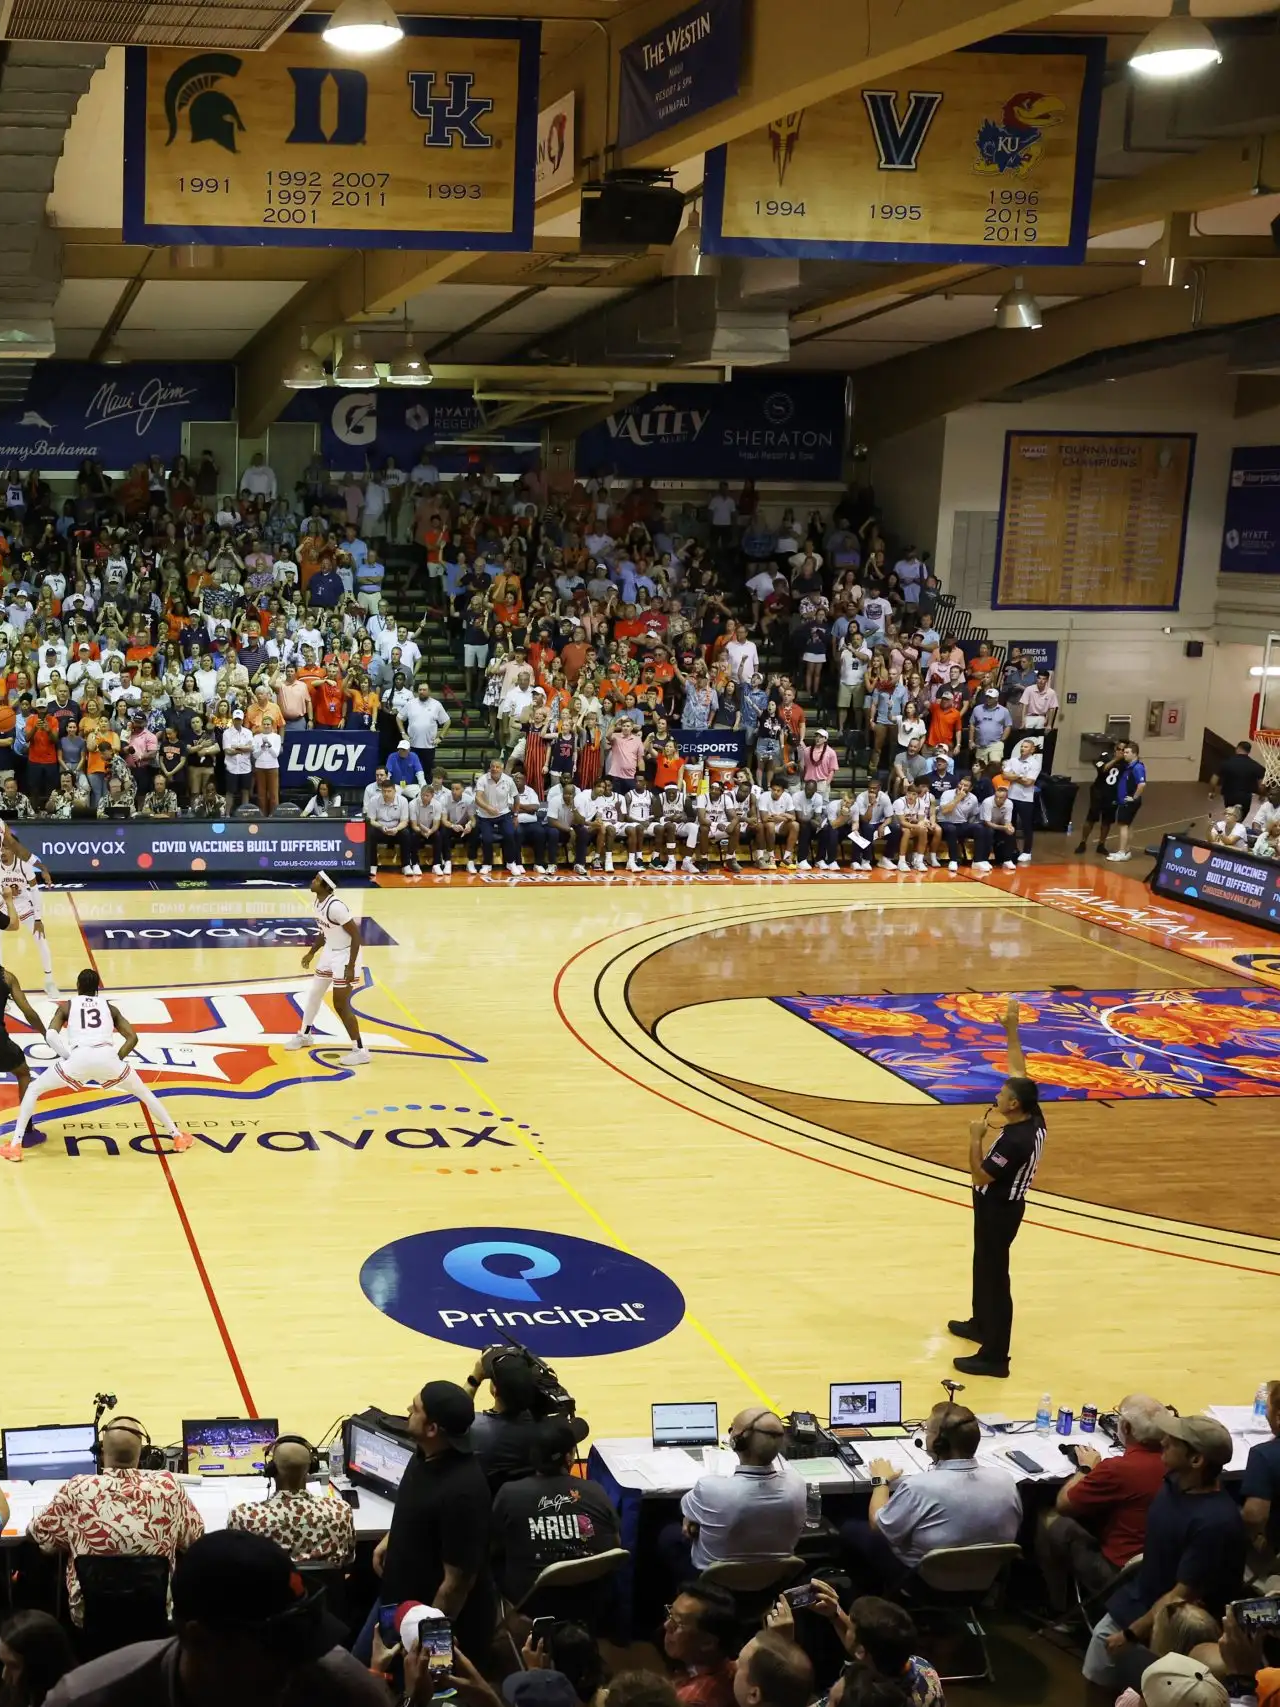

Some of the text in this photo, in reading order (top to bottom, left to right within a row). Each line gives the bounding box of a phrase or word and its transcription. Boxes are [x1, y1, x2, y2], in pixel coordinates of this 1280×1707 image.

[642, 12, 712, 71] THE WESTIN
[997, 136, 1019, 155] KU
[178, 176, 231, 194] 1991
[265, 170, 391, 189] 1992 2007
[265, 189, 388, 208] 1997 2011
[426, 183, 483, 200] 1993
[987, 189, 1040, 206] 1996
[263, 208, 319, 225] 2001
[755, 200, 806, 217] 1994
[869, 204, 922, 221] 1995
[985, 208, 1039, 225] 2015
[983, 227, 1038, 243] 2019
[85, 377, 198, 436] Maui Jim
[434, 407, 482, 417] HYATT
[434, 418, 482, 429] REGEN
[605, 409, 711, 446] VALLEY
[723, 430, 833, 447] SHERATON
[30, 439, 98, 457] Bahama
[1062, 456, 1138, 468] CHAMPIONS
[1022, 647, 1047, 656] OMEN'S
[677, 742, 738, 754] PERSPORTS
[287, 743, 366, 773] LUCY
[1105, 767, 1120, 786] 8
[41, 840, 126, 855] novavax
[152, 839, 342, 854] COVID VACCINES BUILT DIFFERENT
[1165, 862, 1198, 878] novavax
[1210, 857, 1268, 882] COVID VACCINES
[1205, 871, 1225, 887] BUILT
[1226, 878, 1265, 897] DIFFERENT
[80, 1008, 103, 1029] 13
[233, 1119, 262, 1129] BY
[63, 1126, 517, 1157] novavax
[437, 1303, 646, 1329] Principal
[527, 1513, 581, 1541] MAUI
